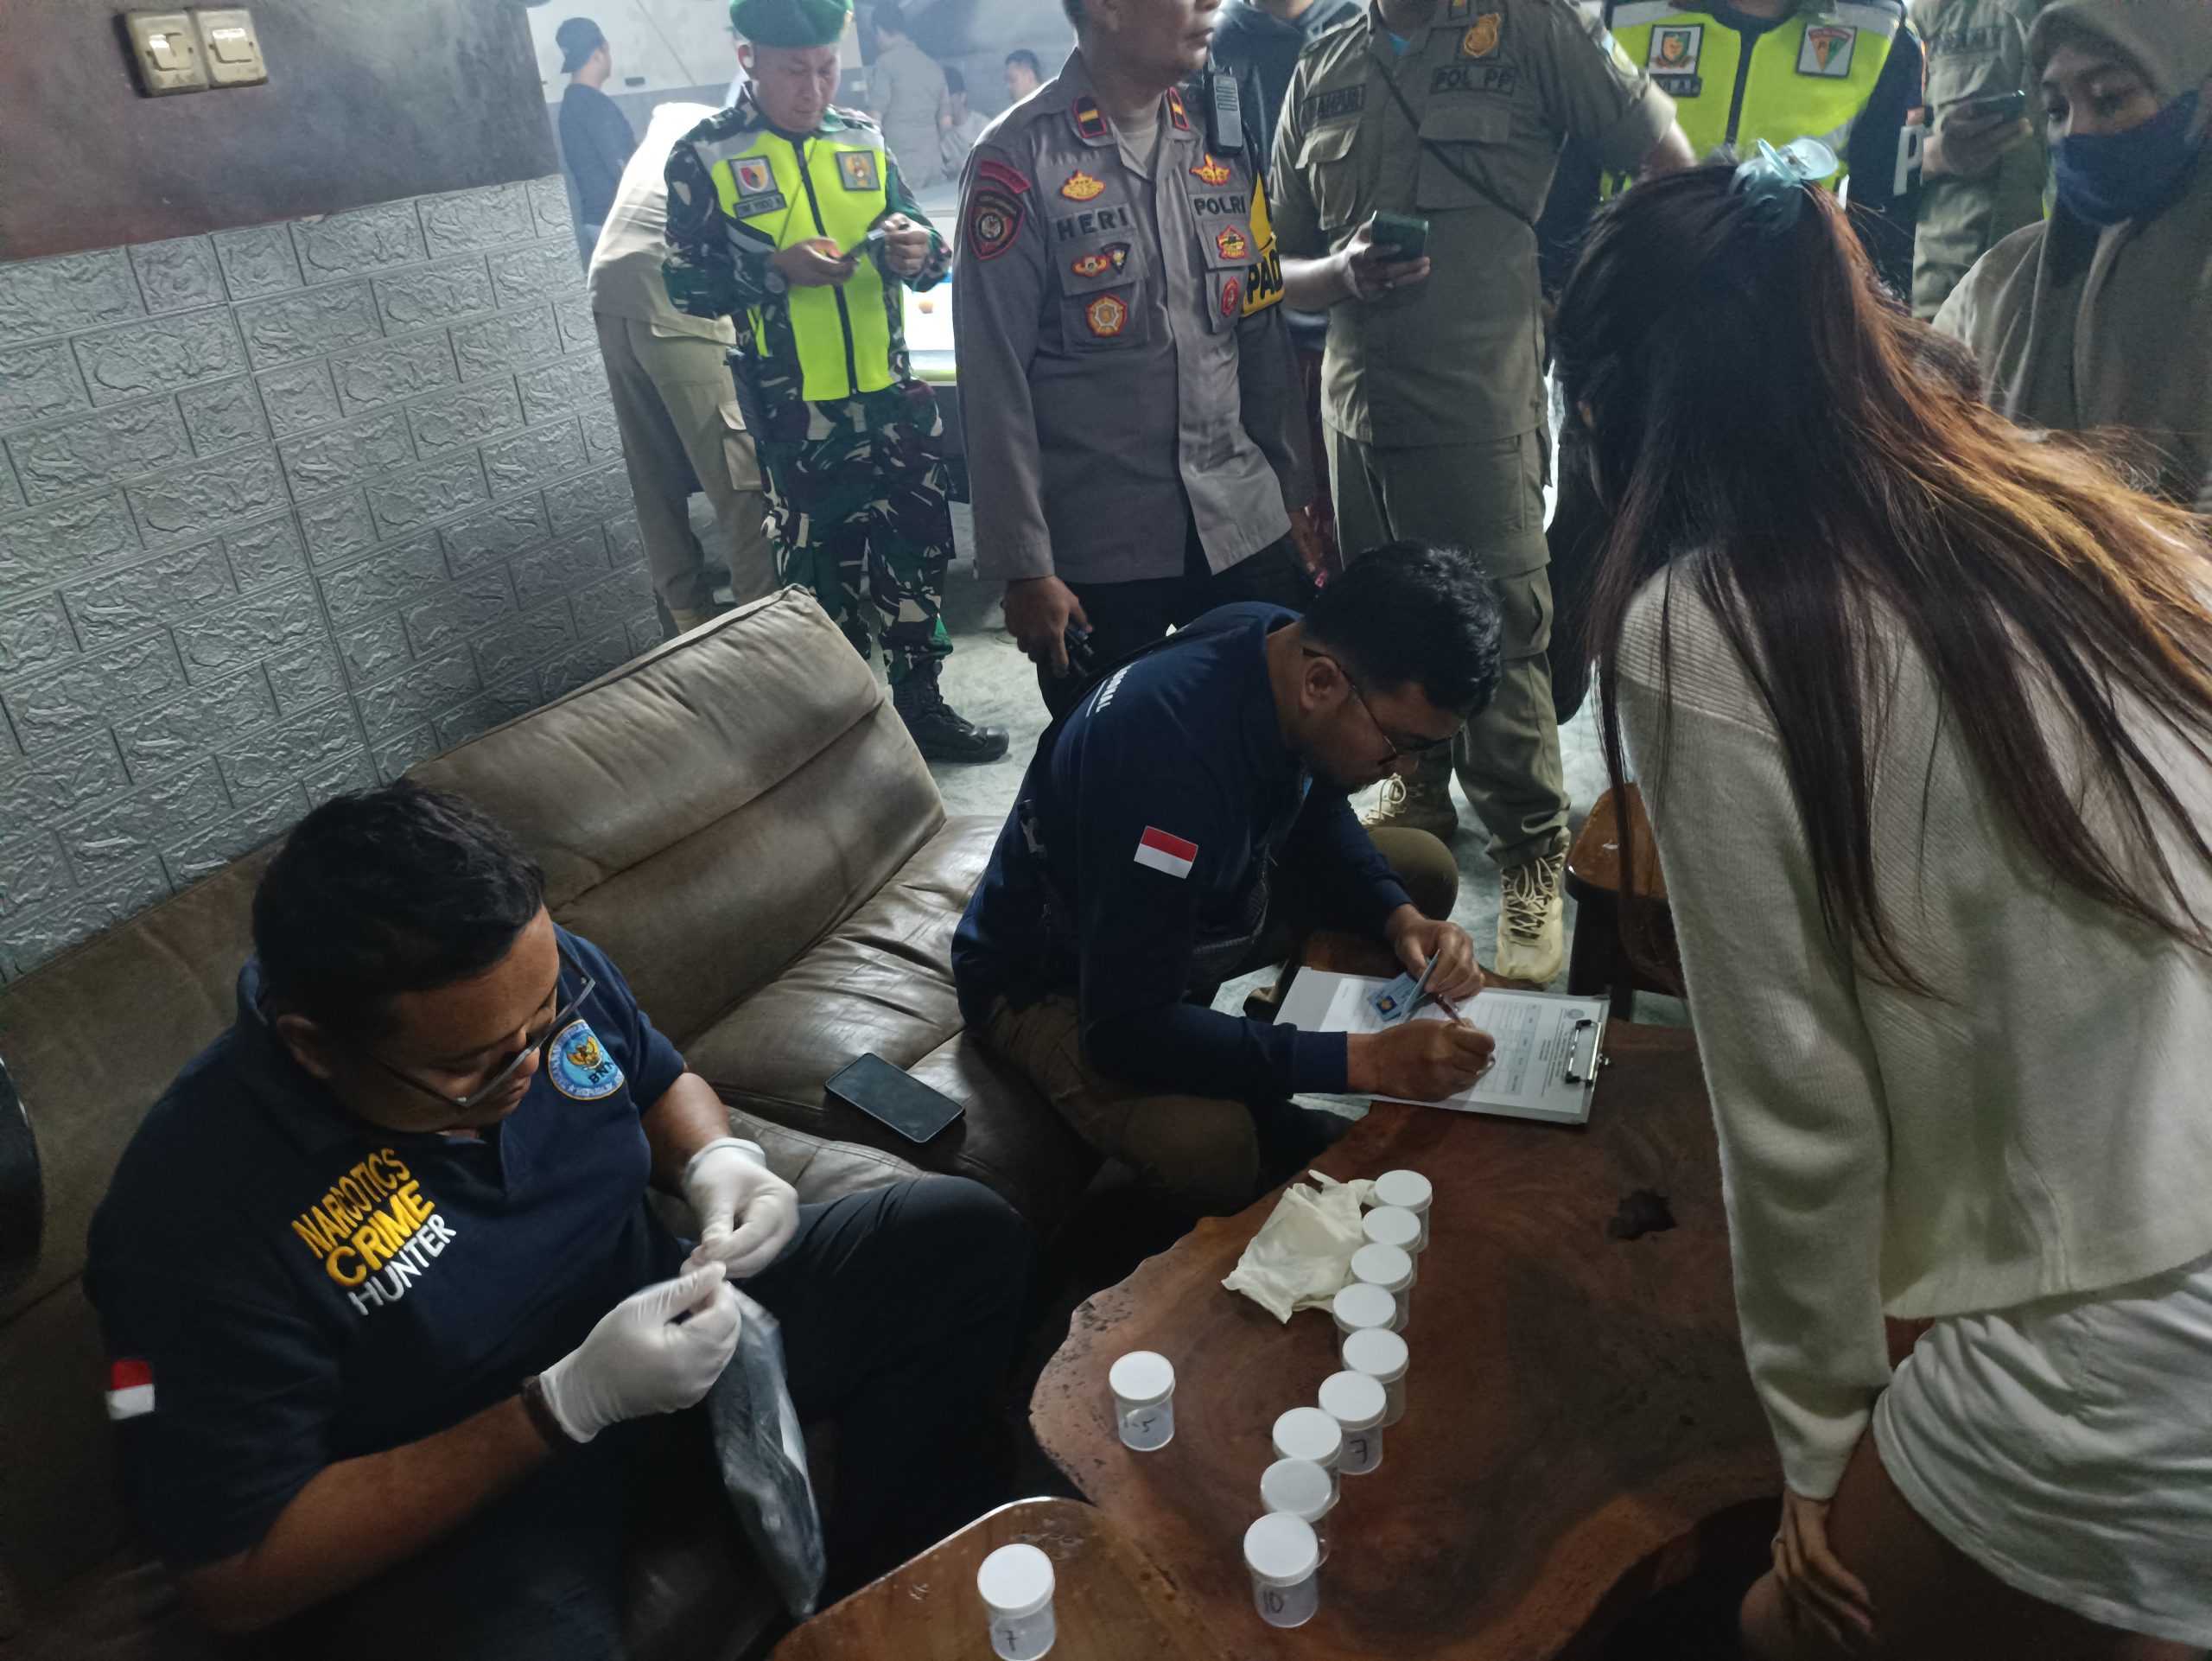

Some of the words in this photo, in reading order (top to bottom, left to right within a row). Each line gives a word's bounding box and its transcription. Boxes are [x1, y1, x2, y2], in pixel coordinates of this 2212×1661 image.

[1057, 207, 1128, 241] HERI
[1193, 195, 1246, 216] POLRI
[291, 1148, 410, 1259] NARCOTICS
[326, 1180, 435, 1287] CRIME
[347, 1214, 457, 1315] HUNTER
[1263, 1590, 1285, 1614] 10
